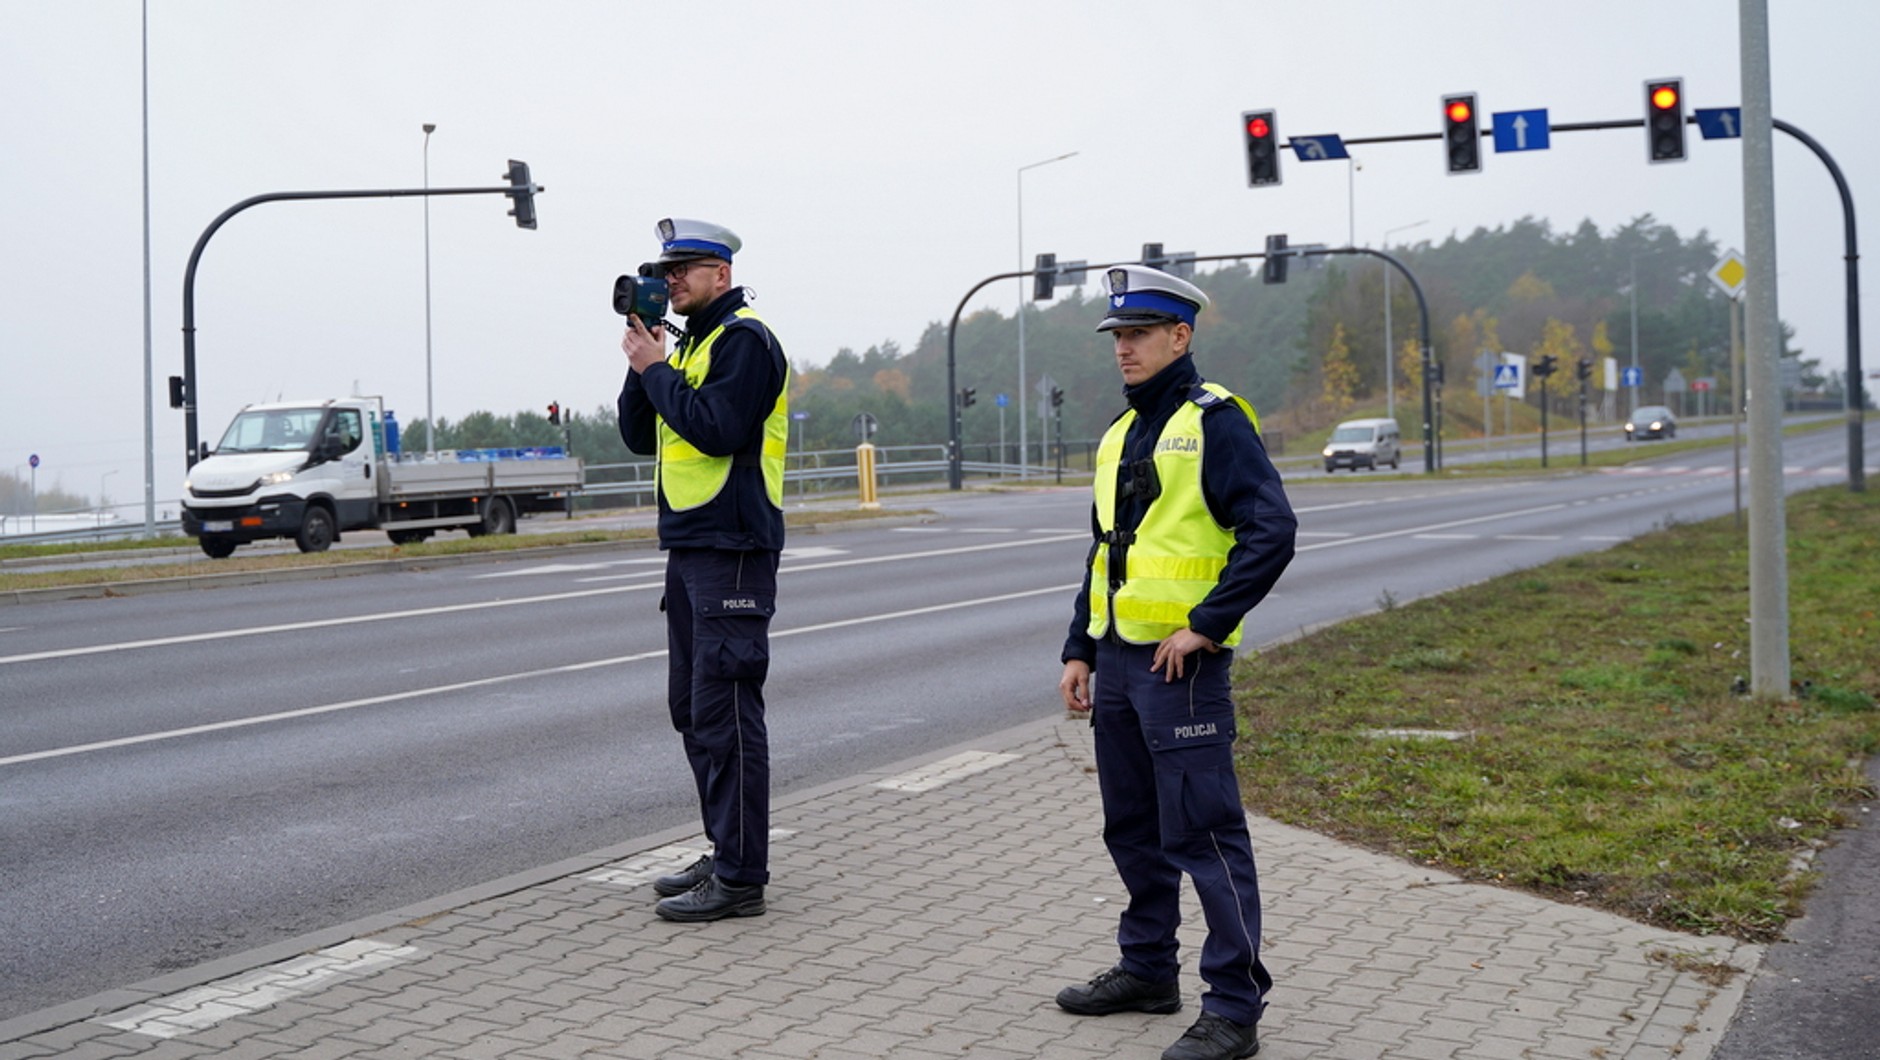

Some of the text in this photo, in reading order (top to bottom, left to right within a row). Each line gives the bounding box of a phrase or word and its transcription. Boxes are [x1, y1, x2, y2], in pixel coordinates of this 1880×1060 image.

[1157, 437, 1198, 452] POLICJA
[722, 599, 757, 609] POLICJA
[1174, 723, 1217, 739] POLICJA
